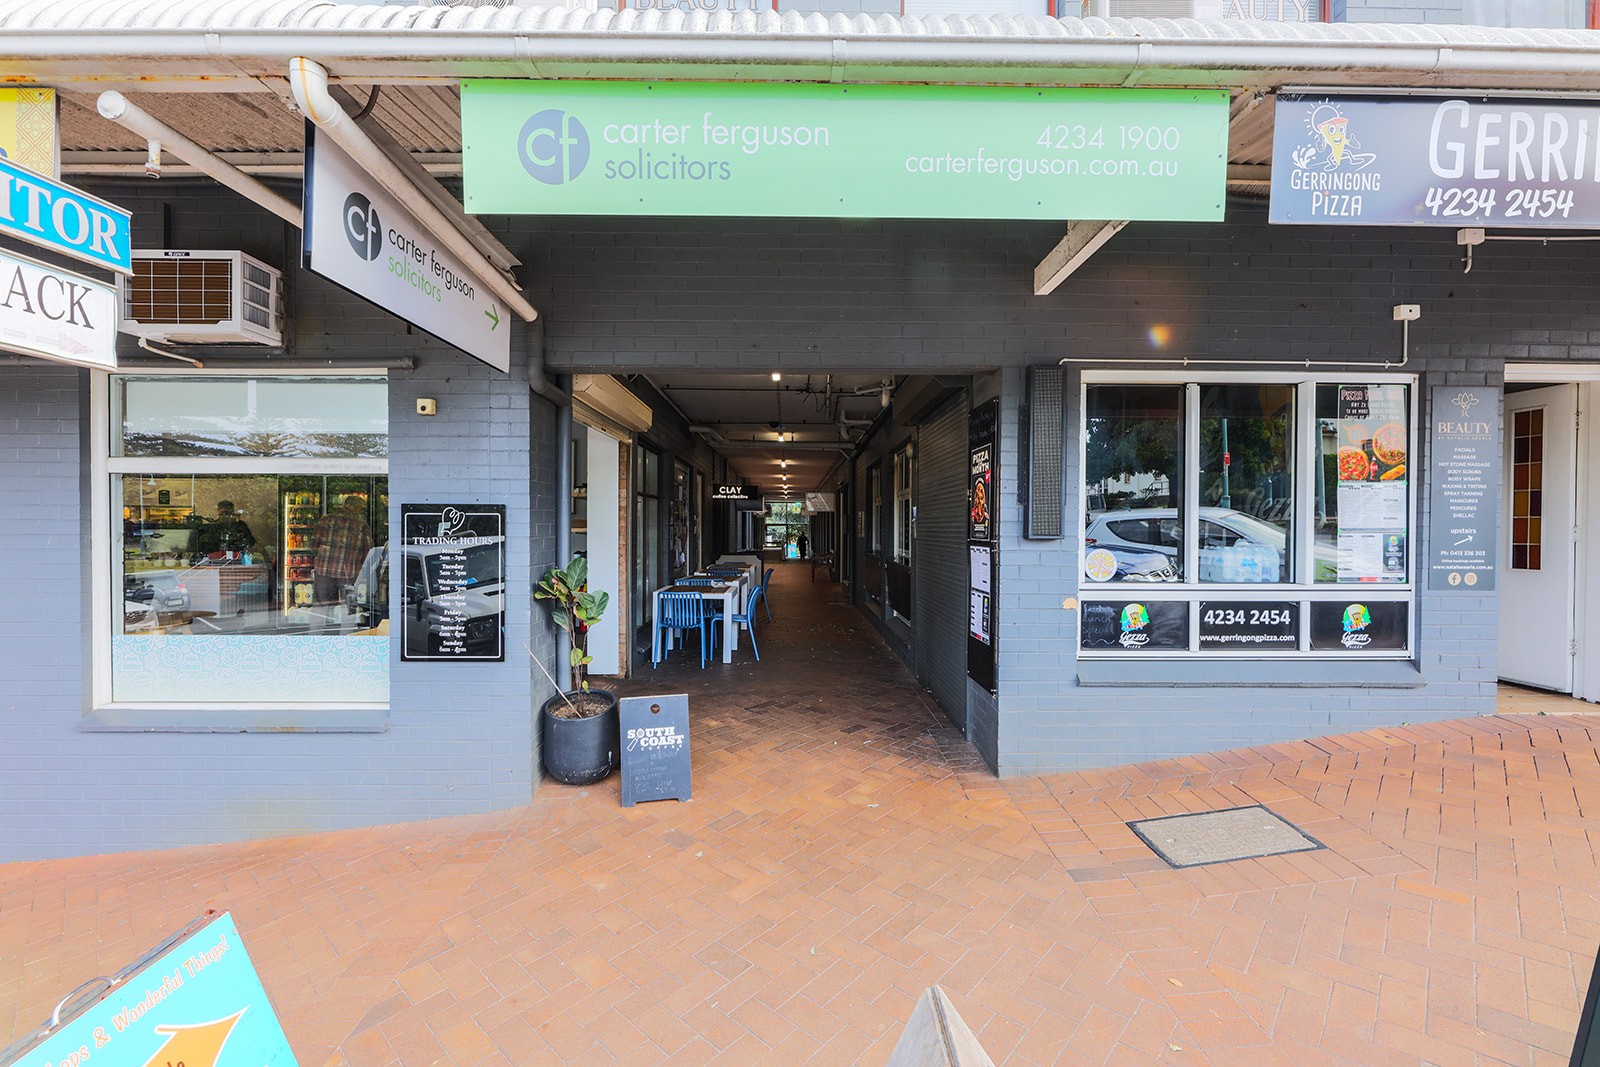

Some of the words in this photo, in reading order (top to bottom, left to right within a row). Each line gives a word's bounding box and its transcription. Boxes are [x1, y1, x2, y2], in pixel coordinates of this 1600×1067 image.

[603, 118, 691, 145] carter
[702, 112, 829, 154] ferguson
[1035, 124, 1105, 150] 4234
[1119, 125, 1180, 151] 1900
[1428, 99, 1600, 183] GERRI
[604, 147, 733, 181] solicitors
[904, 147, 1179, 182] carterferguson.com.au
[1290, 169, 1381, 191] GERRINGONG
[1424, 187, 1497, 217] 4234
[1504, 188, 1575, 218] 2454
[388, 228, 427, 265] carter
[430, 250, 475, 301] ferguson
[388, 256, 442, 302] solicitors
[0, 262, 95, 330] ACK
[1438, 422, 1492, 434] BEAUTY
[719, 486, 742, 494] CLAY
[412, 536, 458, 545] TRADING
[460, 536, 494, 546] HOURS
[1204, 609, 1246, 625] 4234
[1249, 609, 1291, 625] 2454
[1199, 634, 1295, 643] www.gerringongpizza.com
[627, 726, 675, 739] SOUTH
[640, 734, 684, 747] COAST
[92, 1027, 111, 1049] &
[112, 969, 184, 1034] Wonderful
[182, 934, 229, 978] Things!
